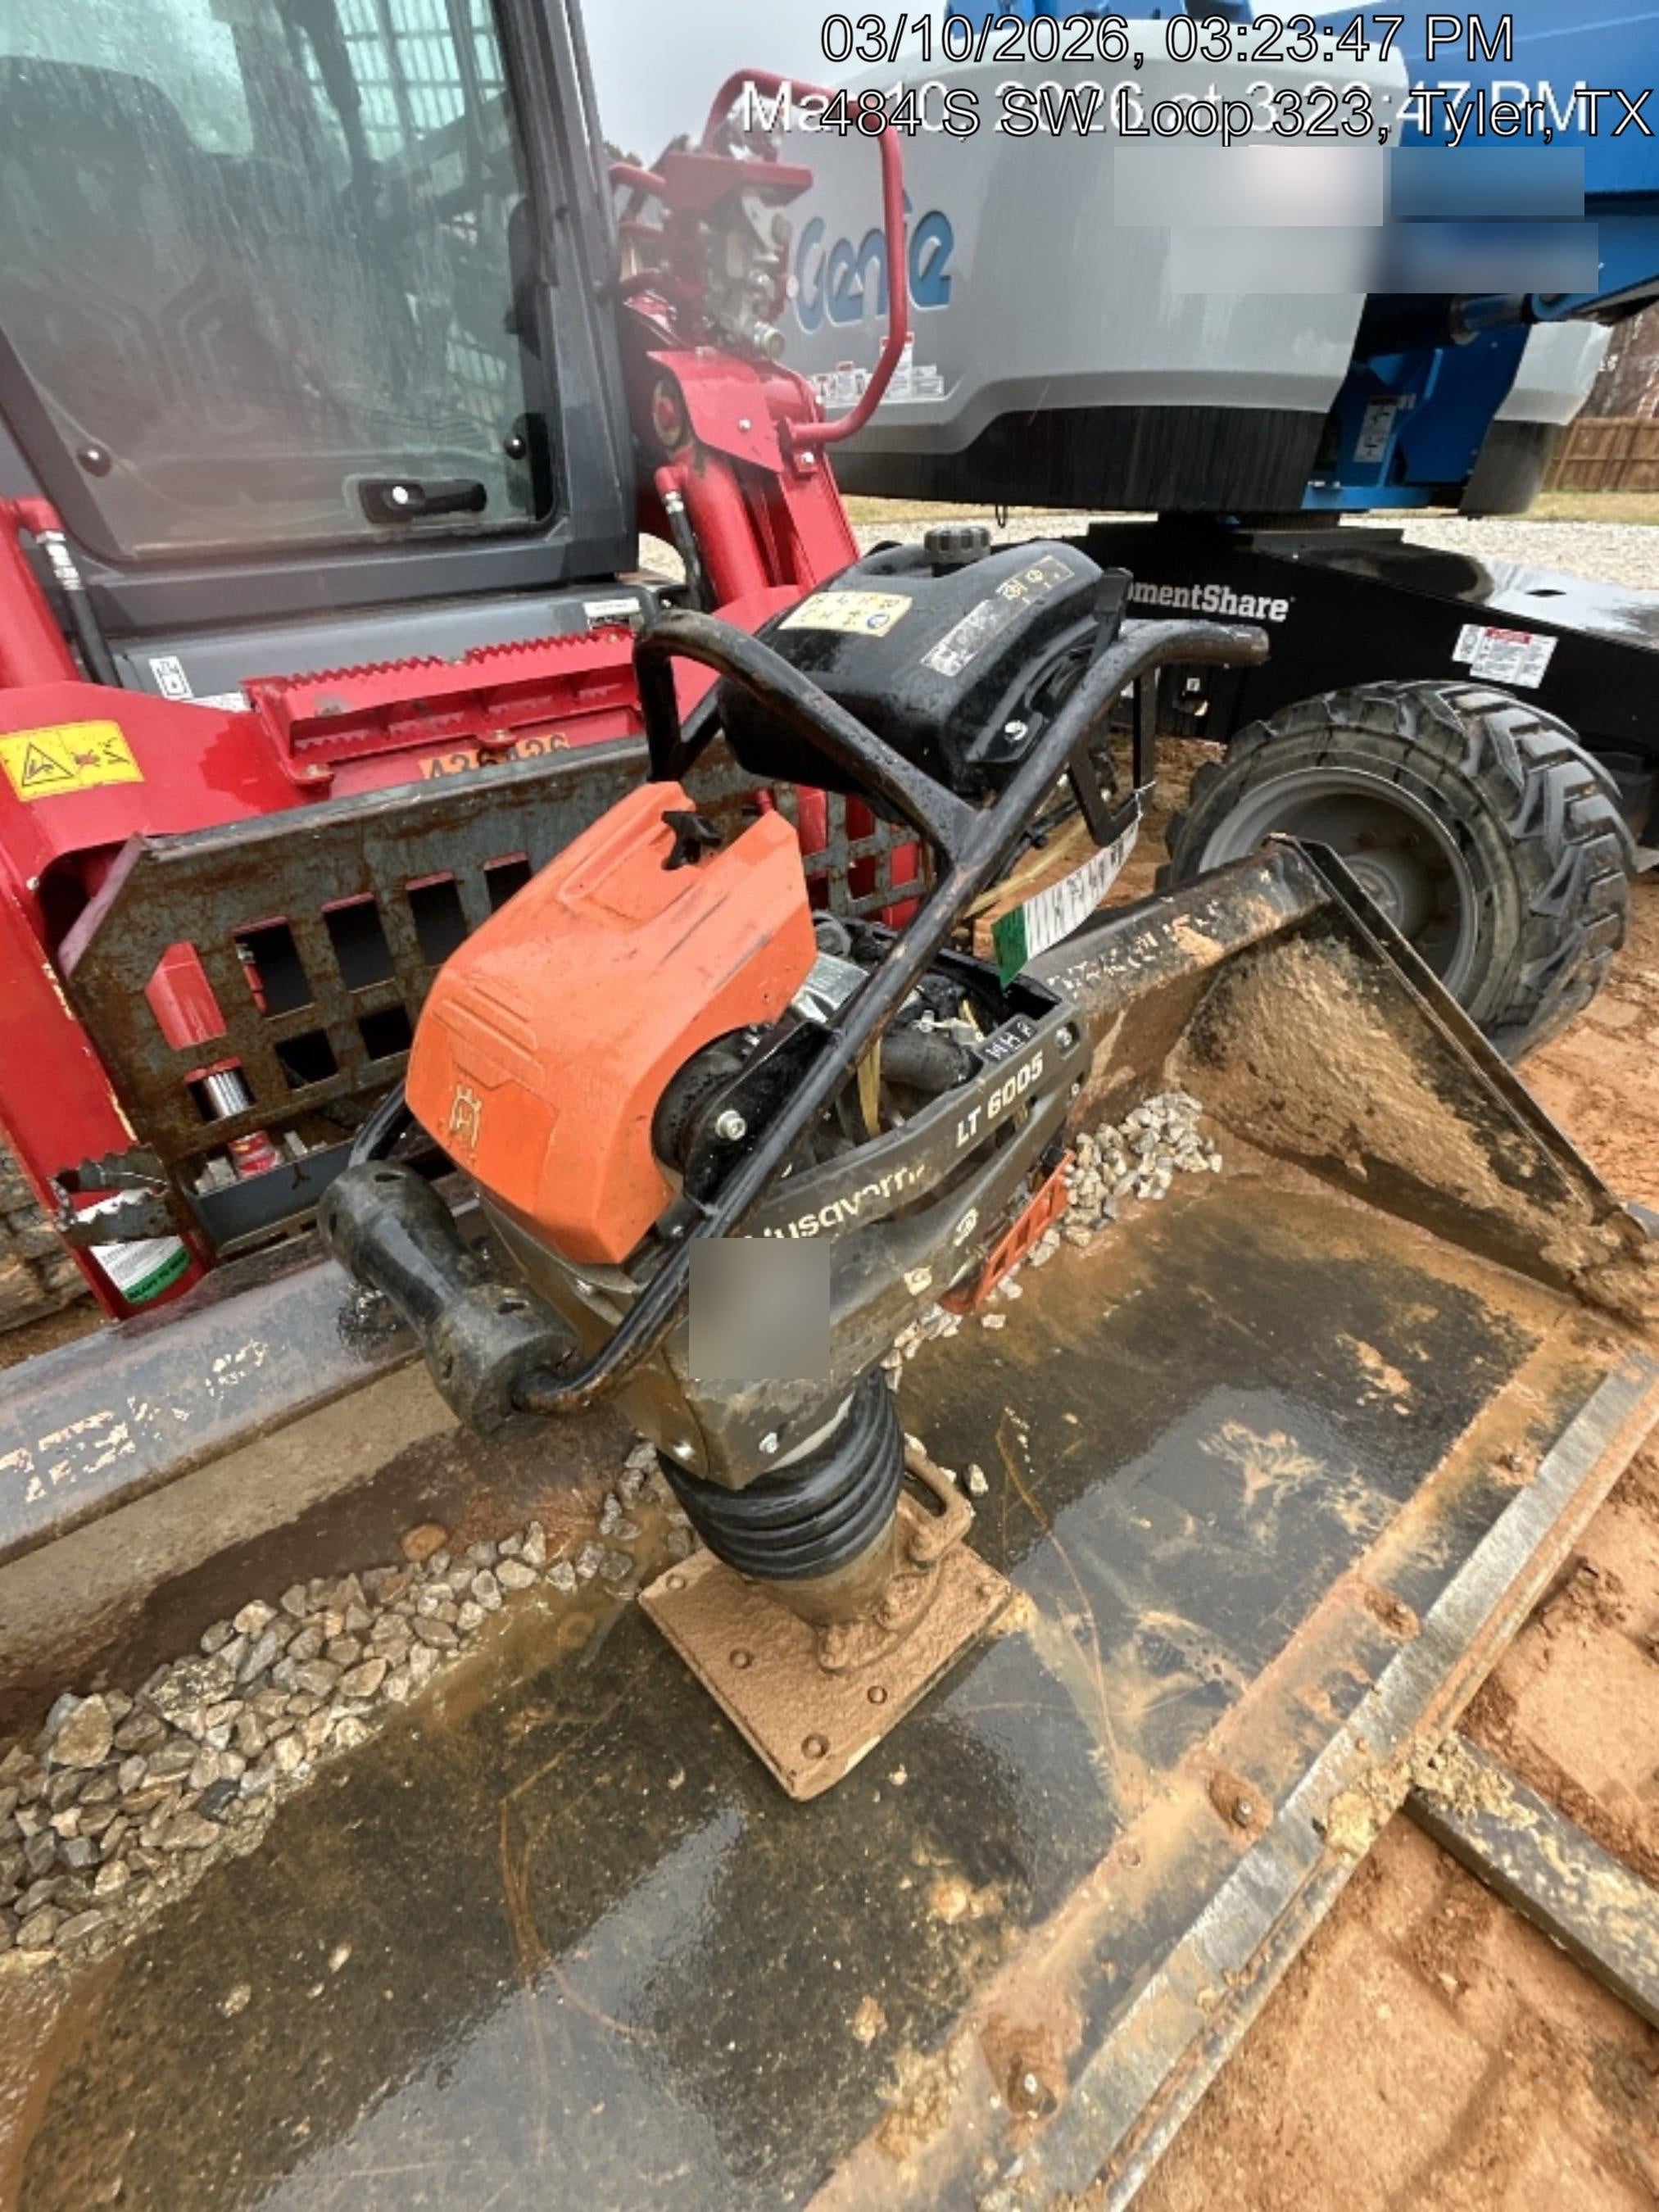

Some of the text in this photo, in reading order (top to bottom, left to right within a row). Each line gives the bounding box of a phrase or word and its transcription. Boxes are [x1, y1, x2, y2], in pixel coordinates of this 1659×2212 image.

[794, 189, 955, 335] Gene
[1126, 582, 1290, 623] mentShare
[955, 1049, 1044, 1149] LT 6005
